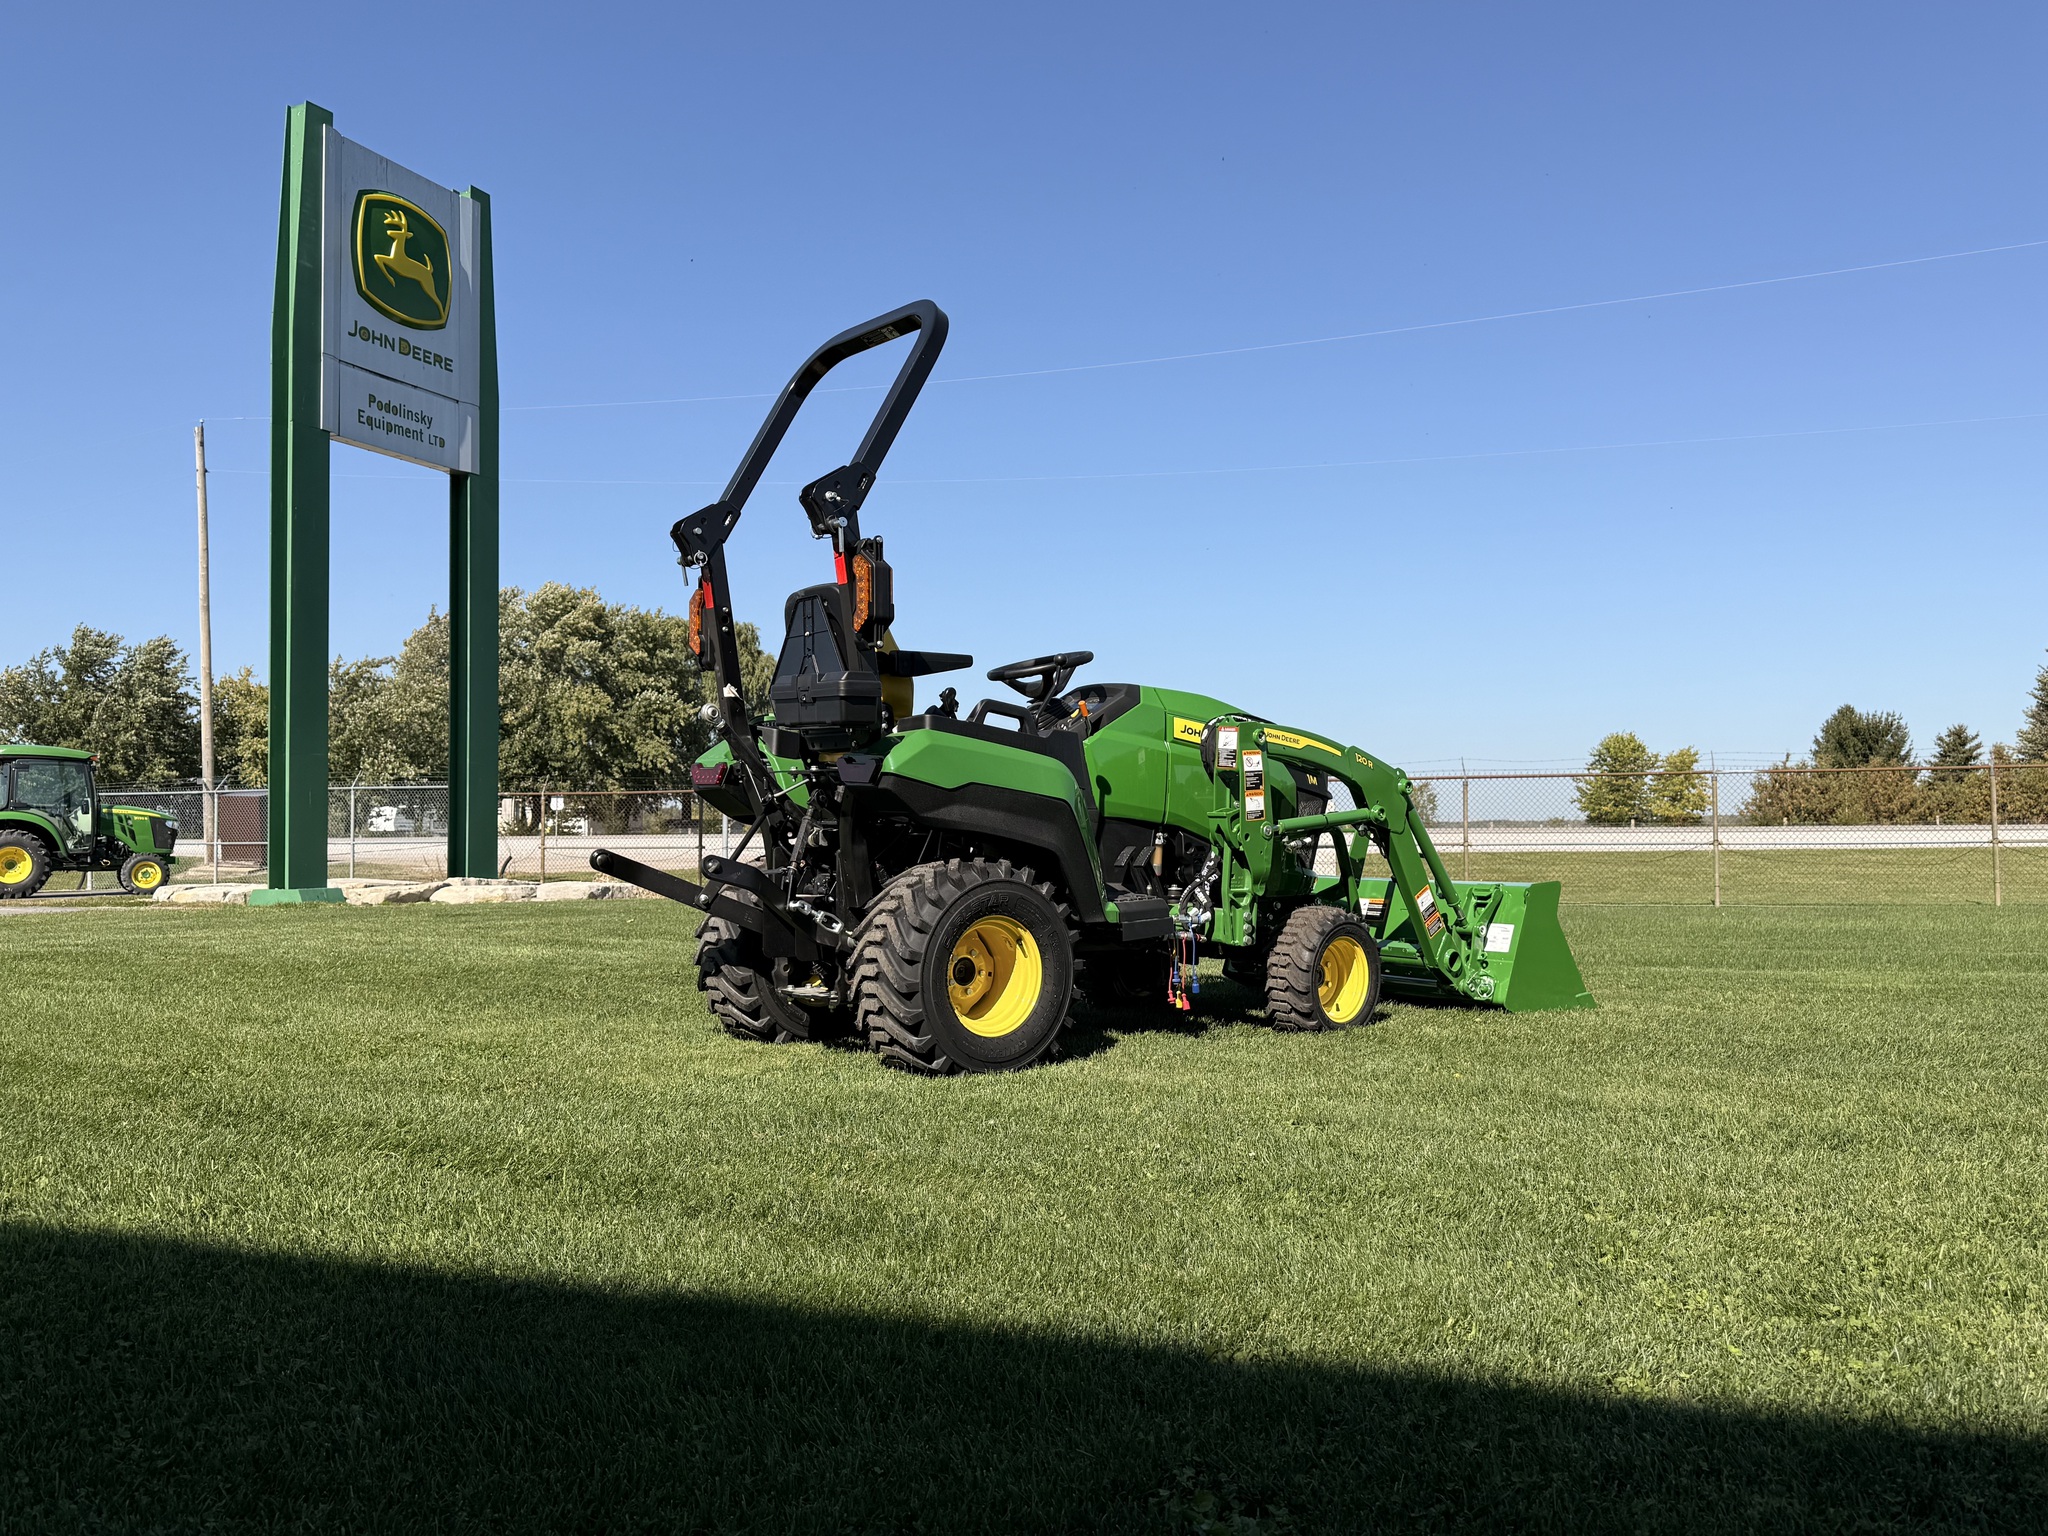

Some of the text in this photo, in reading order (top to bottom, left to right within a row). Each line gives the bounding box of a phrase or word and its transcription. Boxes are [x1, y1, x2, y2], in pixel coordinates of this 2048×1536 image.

[348, 320, 453, 372] JOHN DEERE
[358, 409, 445, 448] Equipment LTD
[369, 393, 433, 429] Podolinsky
[1180, 724, 1201, 737] JOH
[1265, 731, 1301, 745] JOHN DEERE
